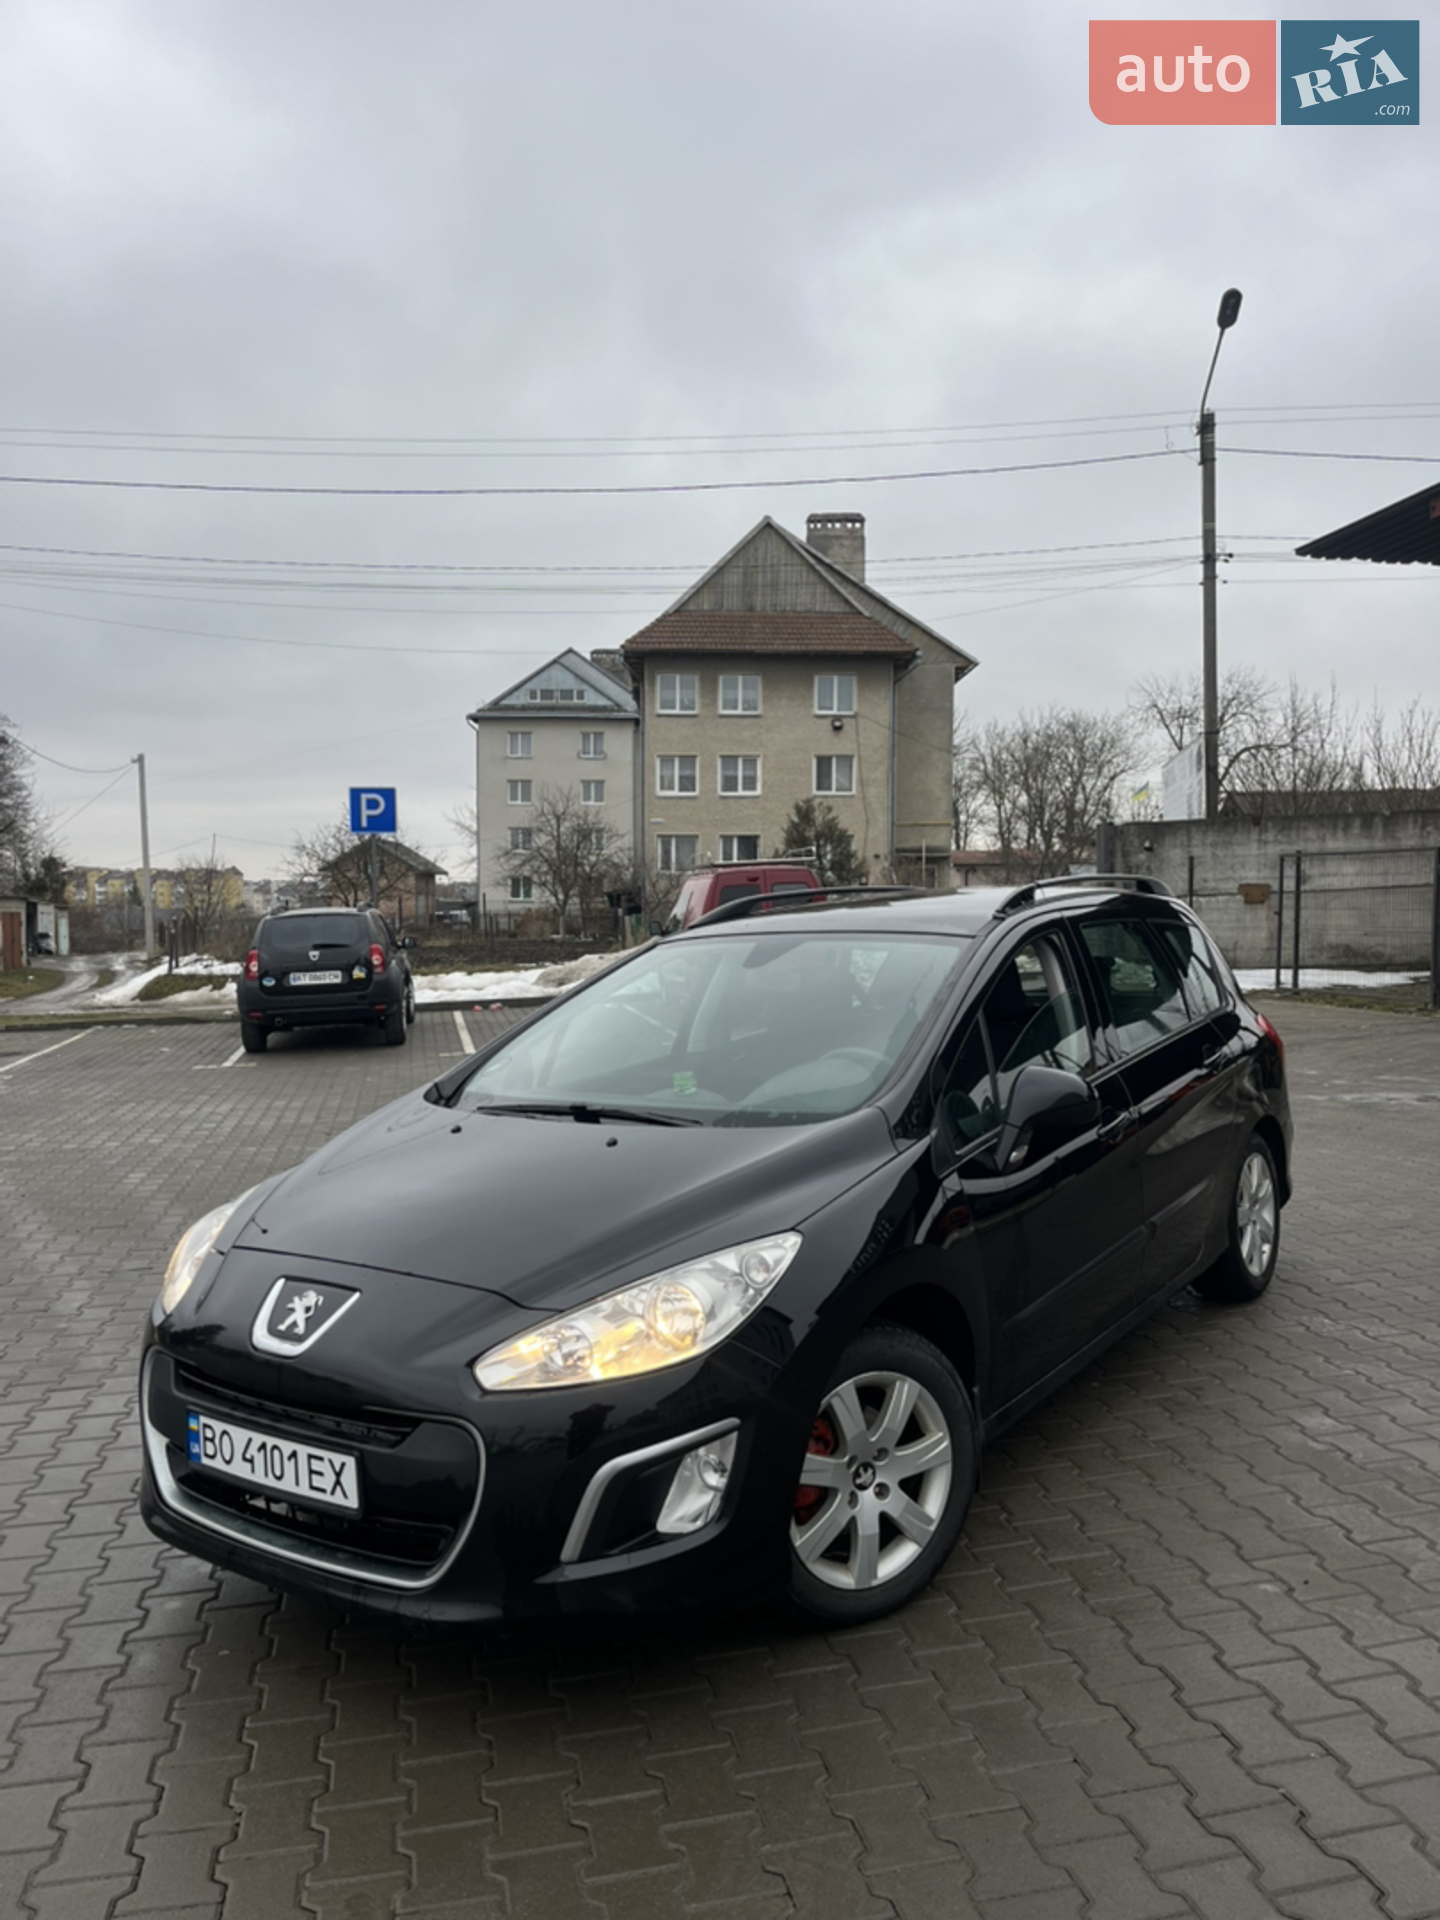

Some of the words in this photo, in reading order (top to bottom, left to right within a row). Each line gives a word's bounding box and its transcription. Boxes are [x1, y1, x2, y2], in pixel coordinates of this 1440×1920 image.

[360, 793, 386, 828] P
[202, 1423, 235, 1465] BO
[241, 1437, 299, 1487] 4101
[306, 1453, 349, 1499] EX
